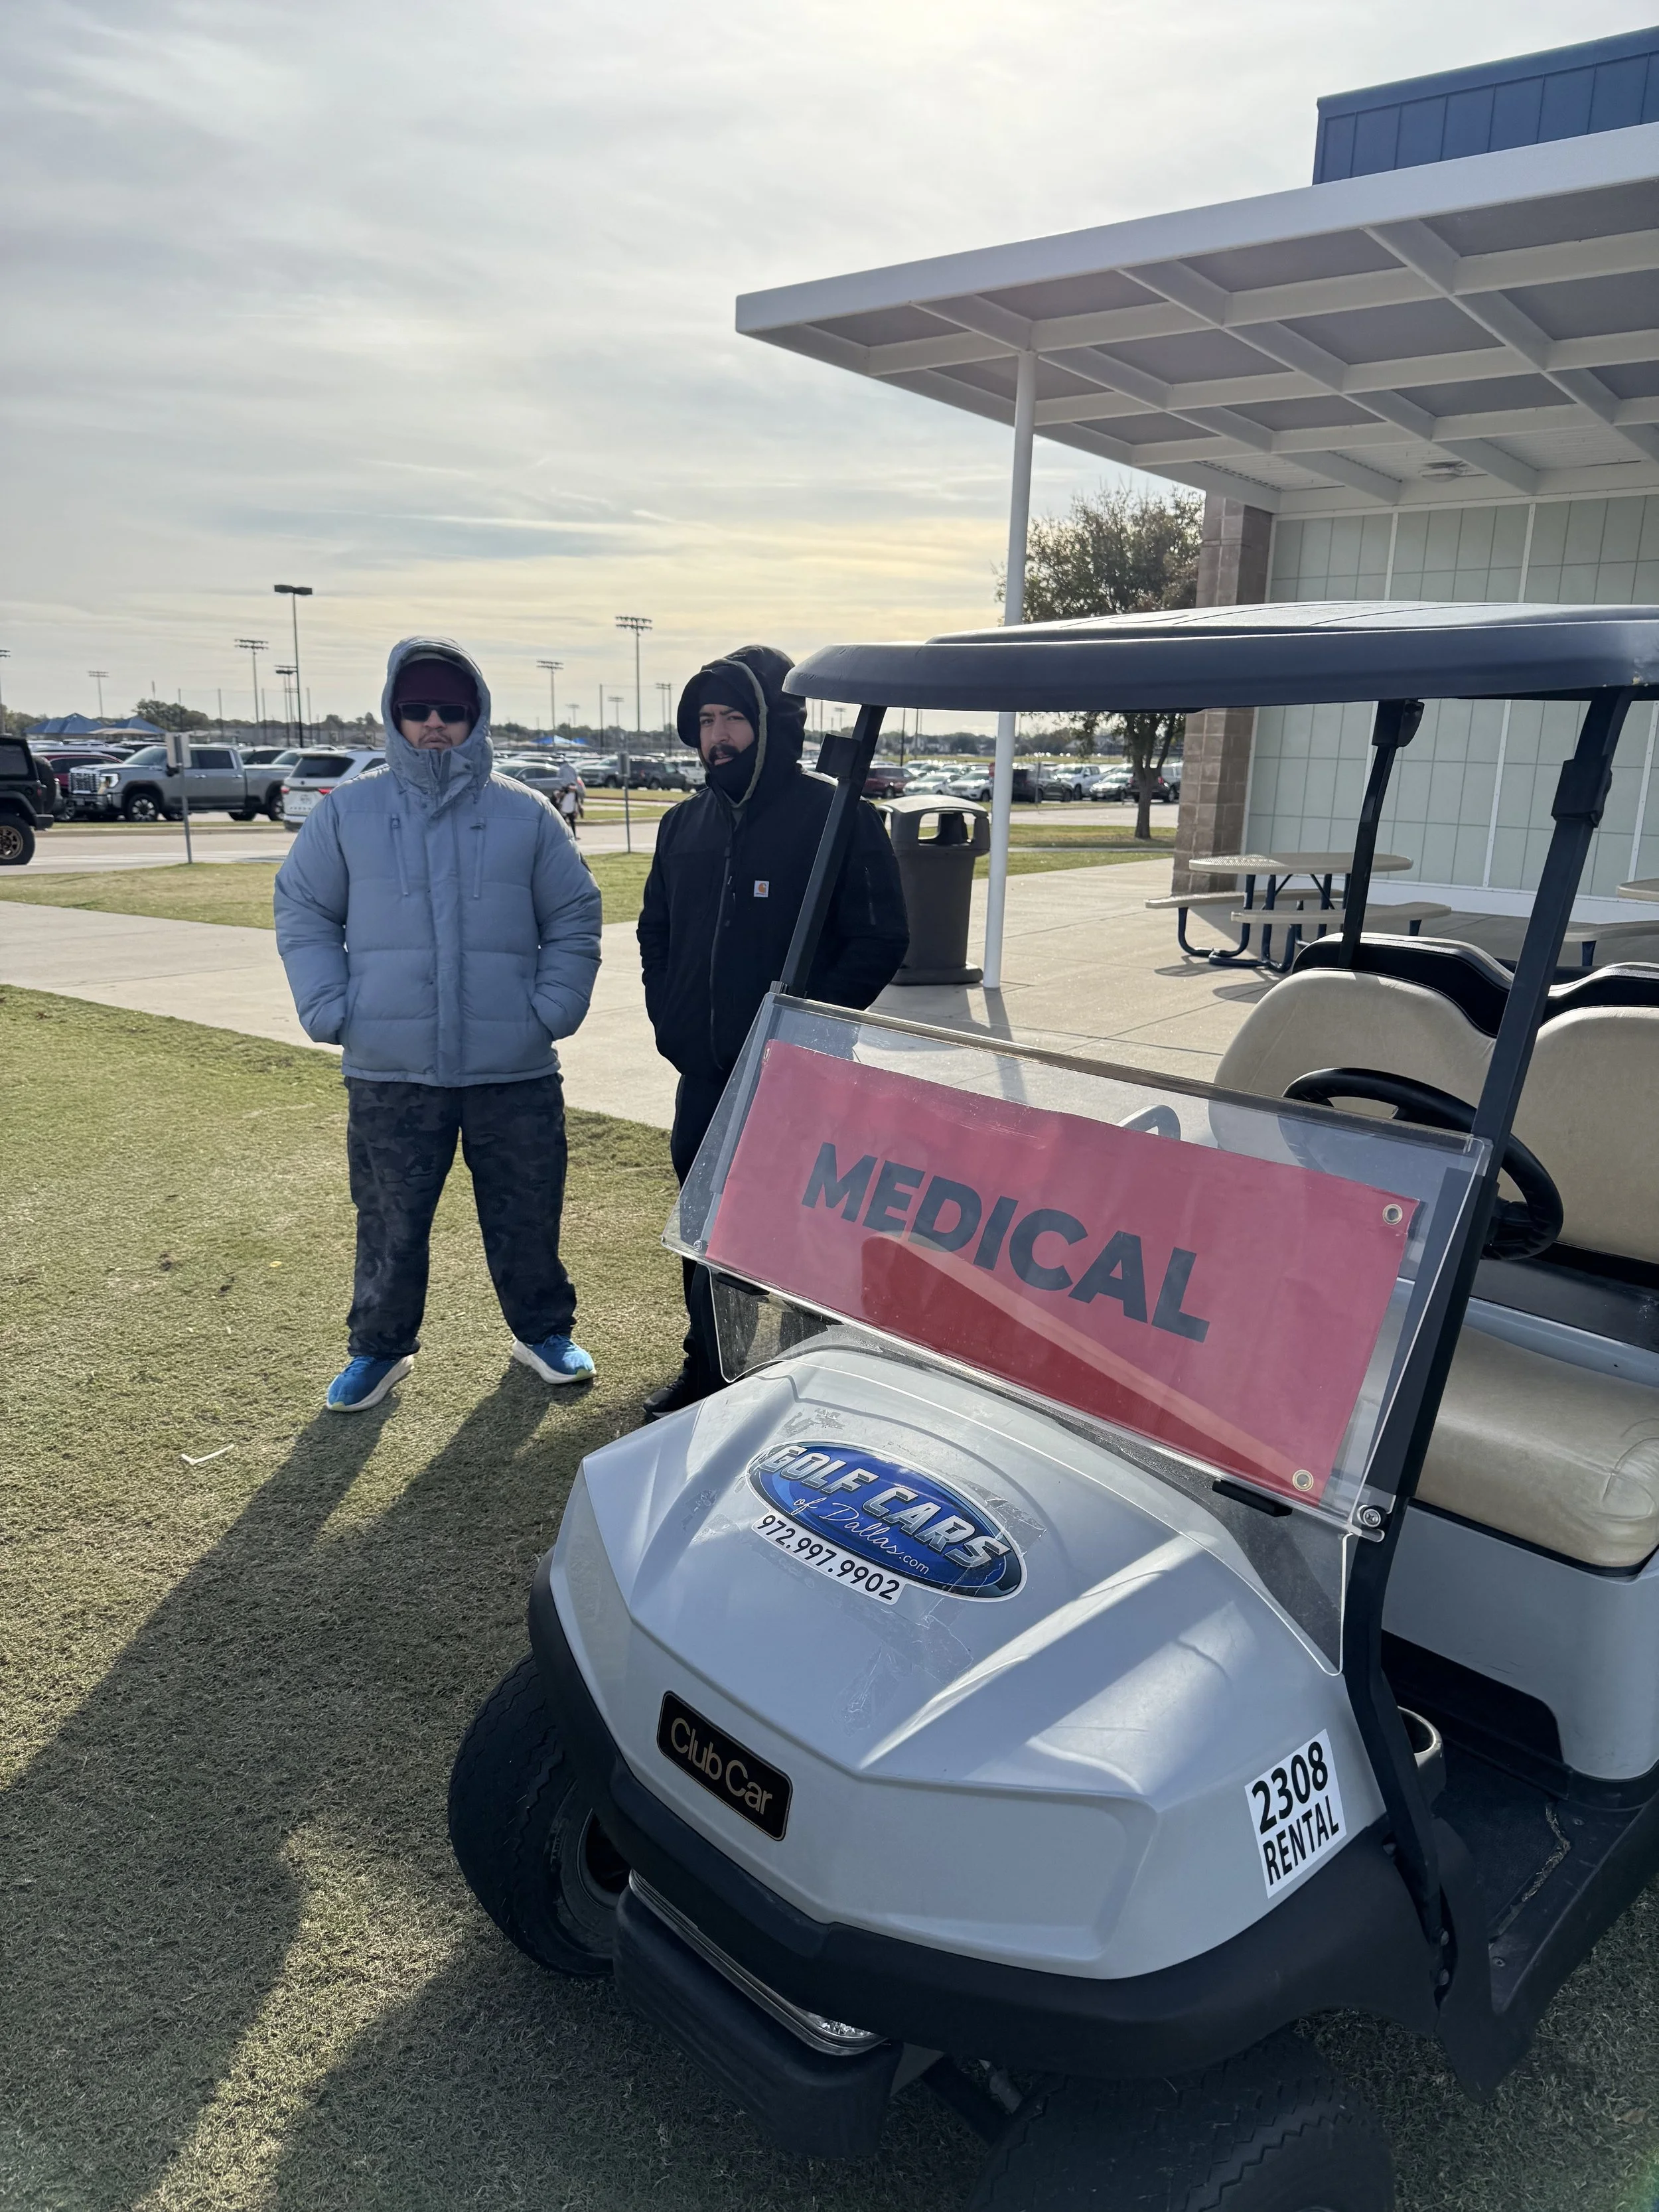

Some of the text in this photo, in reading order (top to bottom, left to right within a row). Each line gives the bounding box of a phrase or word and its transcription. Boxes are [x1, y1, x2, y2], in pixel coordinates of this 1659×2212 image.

[801, 1142, 1210, 1343] MEDICAL
[759, 1445, 1012, 1568] GOLF CARS
[790, 1497, 930, 1575] of Dallas.com
[757, 1514, 900, 1601] 972.997.9902
[670, 1717, 773, 1815] Club Car
[1252, 1741, 1329, 1835] 2308
[1263, 1795, 1340, 1886] RENTAL
